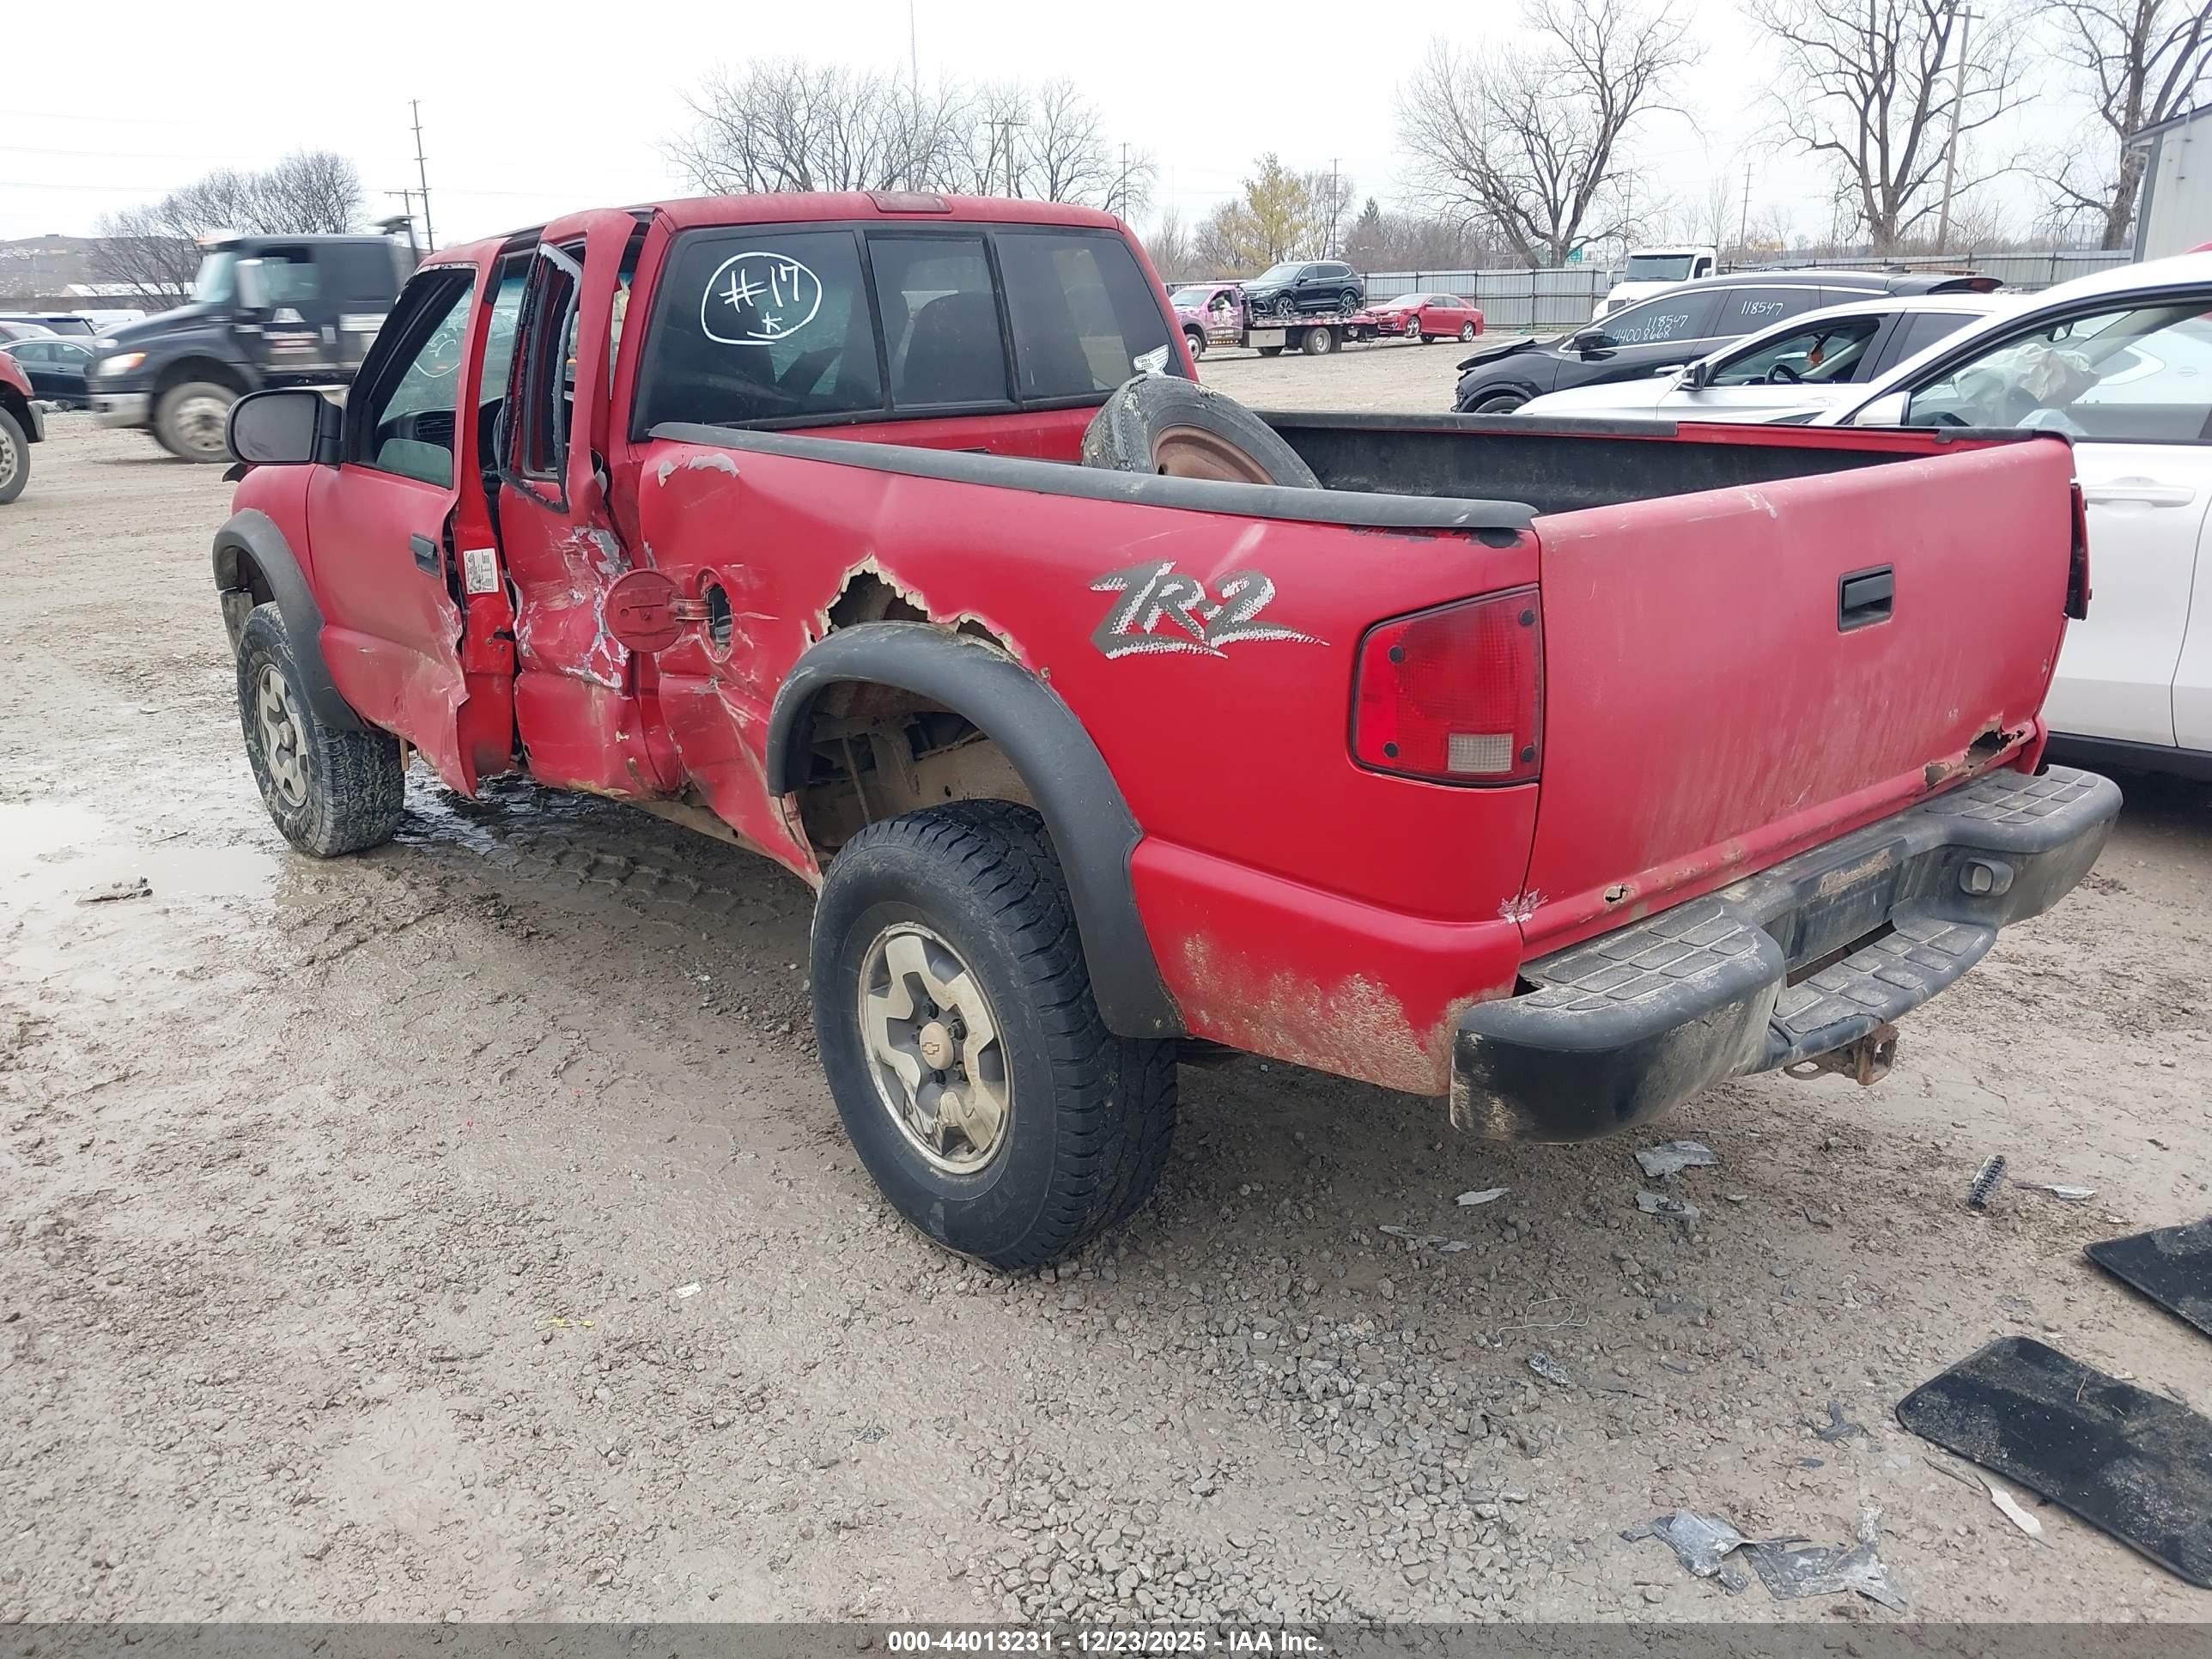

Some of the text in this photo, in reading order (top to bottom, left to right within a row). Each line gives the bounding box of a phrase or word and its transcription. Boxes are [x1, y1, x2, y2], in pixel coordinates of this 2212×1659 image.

[718, 263, 800, 313] #17
[1741, 301, 1784, 316] 118547
[1647, 314, 1689, 329] 118547
